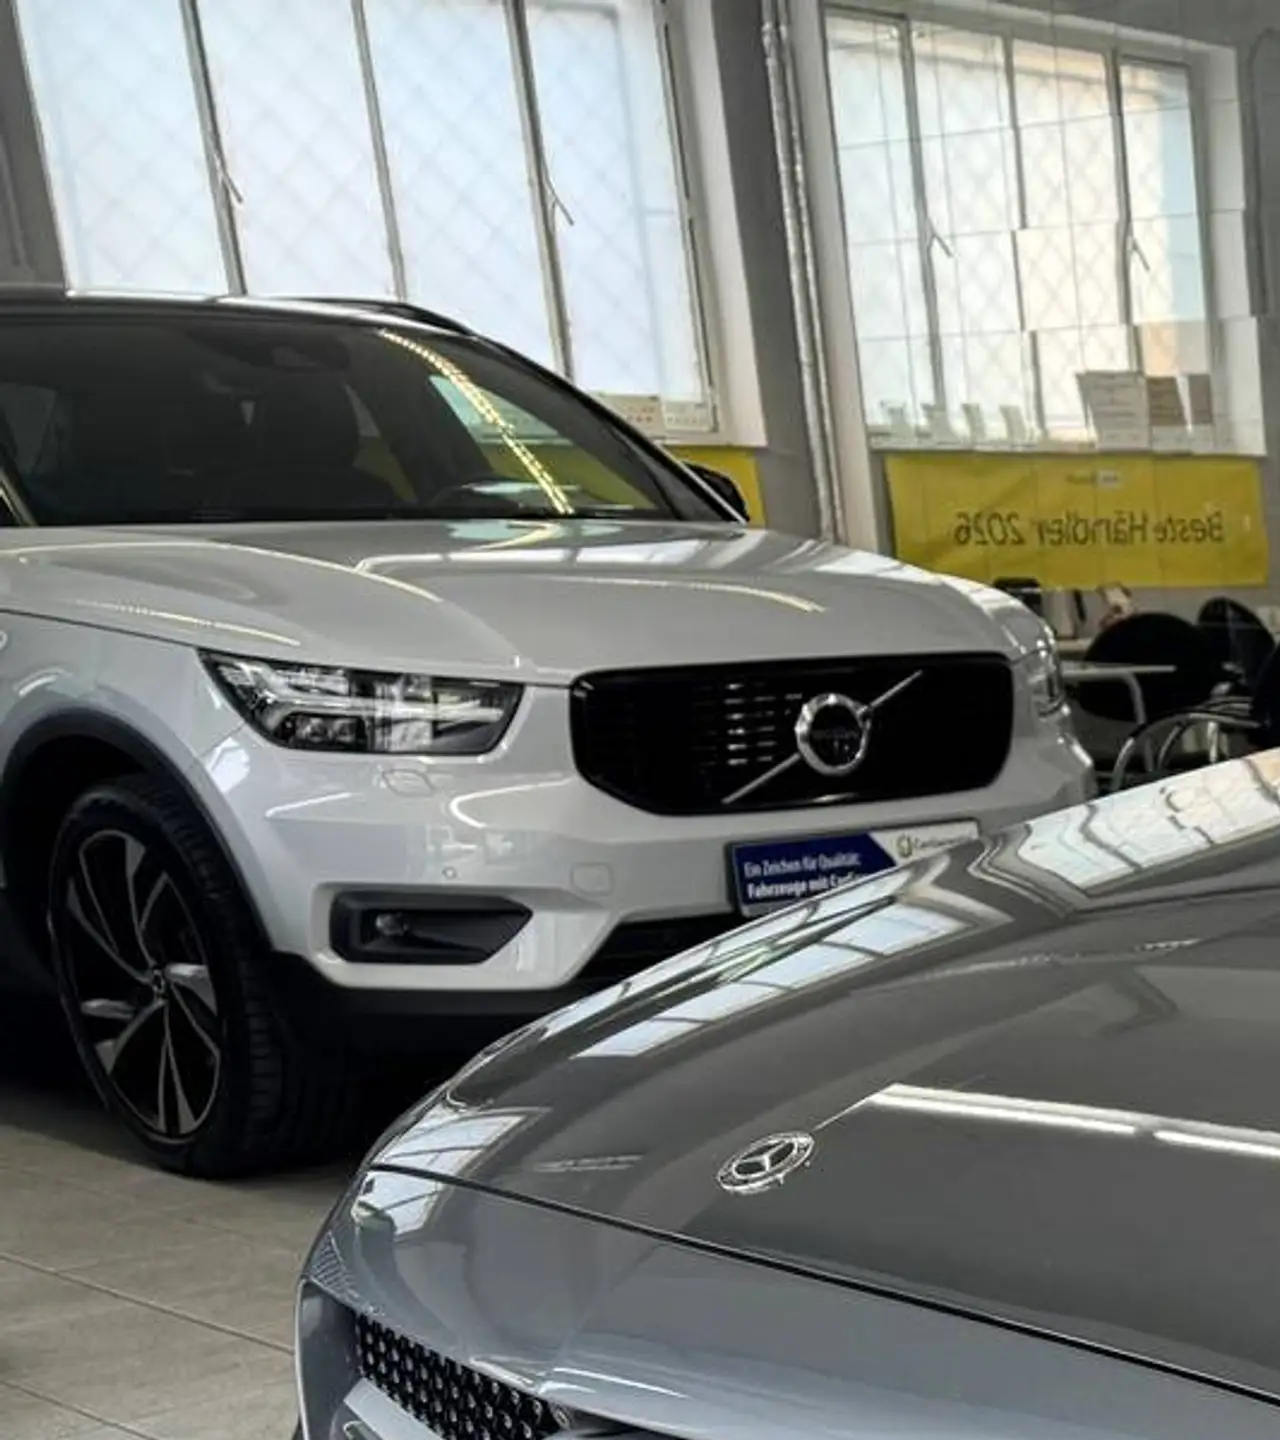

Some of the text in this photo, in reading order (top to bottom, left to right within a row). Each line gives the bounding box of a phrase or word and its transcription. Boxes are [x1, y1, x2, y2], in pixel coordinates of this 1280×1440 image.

[744, 861, 762, 878] Ein
[762, 858, 801, 877] Zeichen
[802, 855, 817, 871] für
[747, 881, 807, 898] Fahrzeuge
[808, 875, 829, 892] mit
